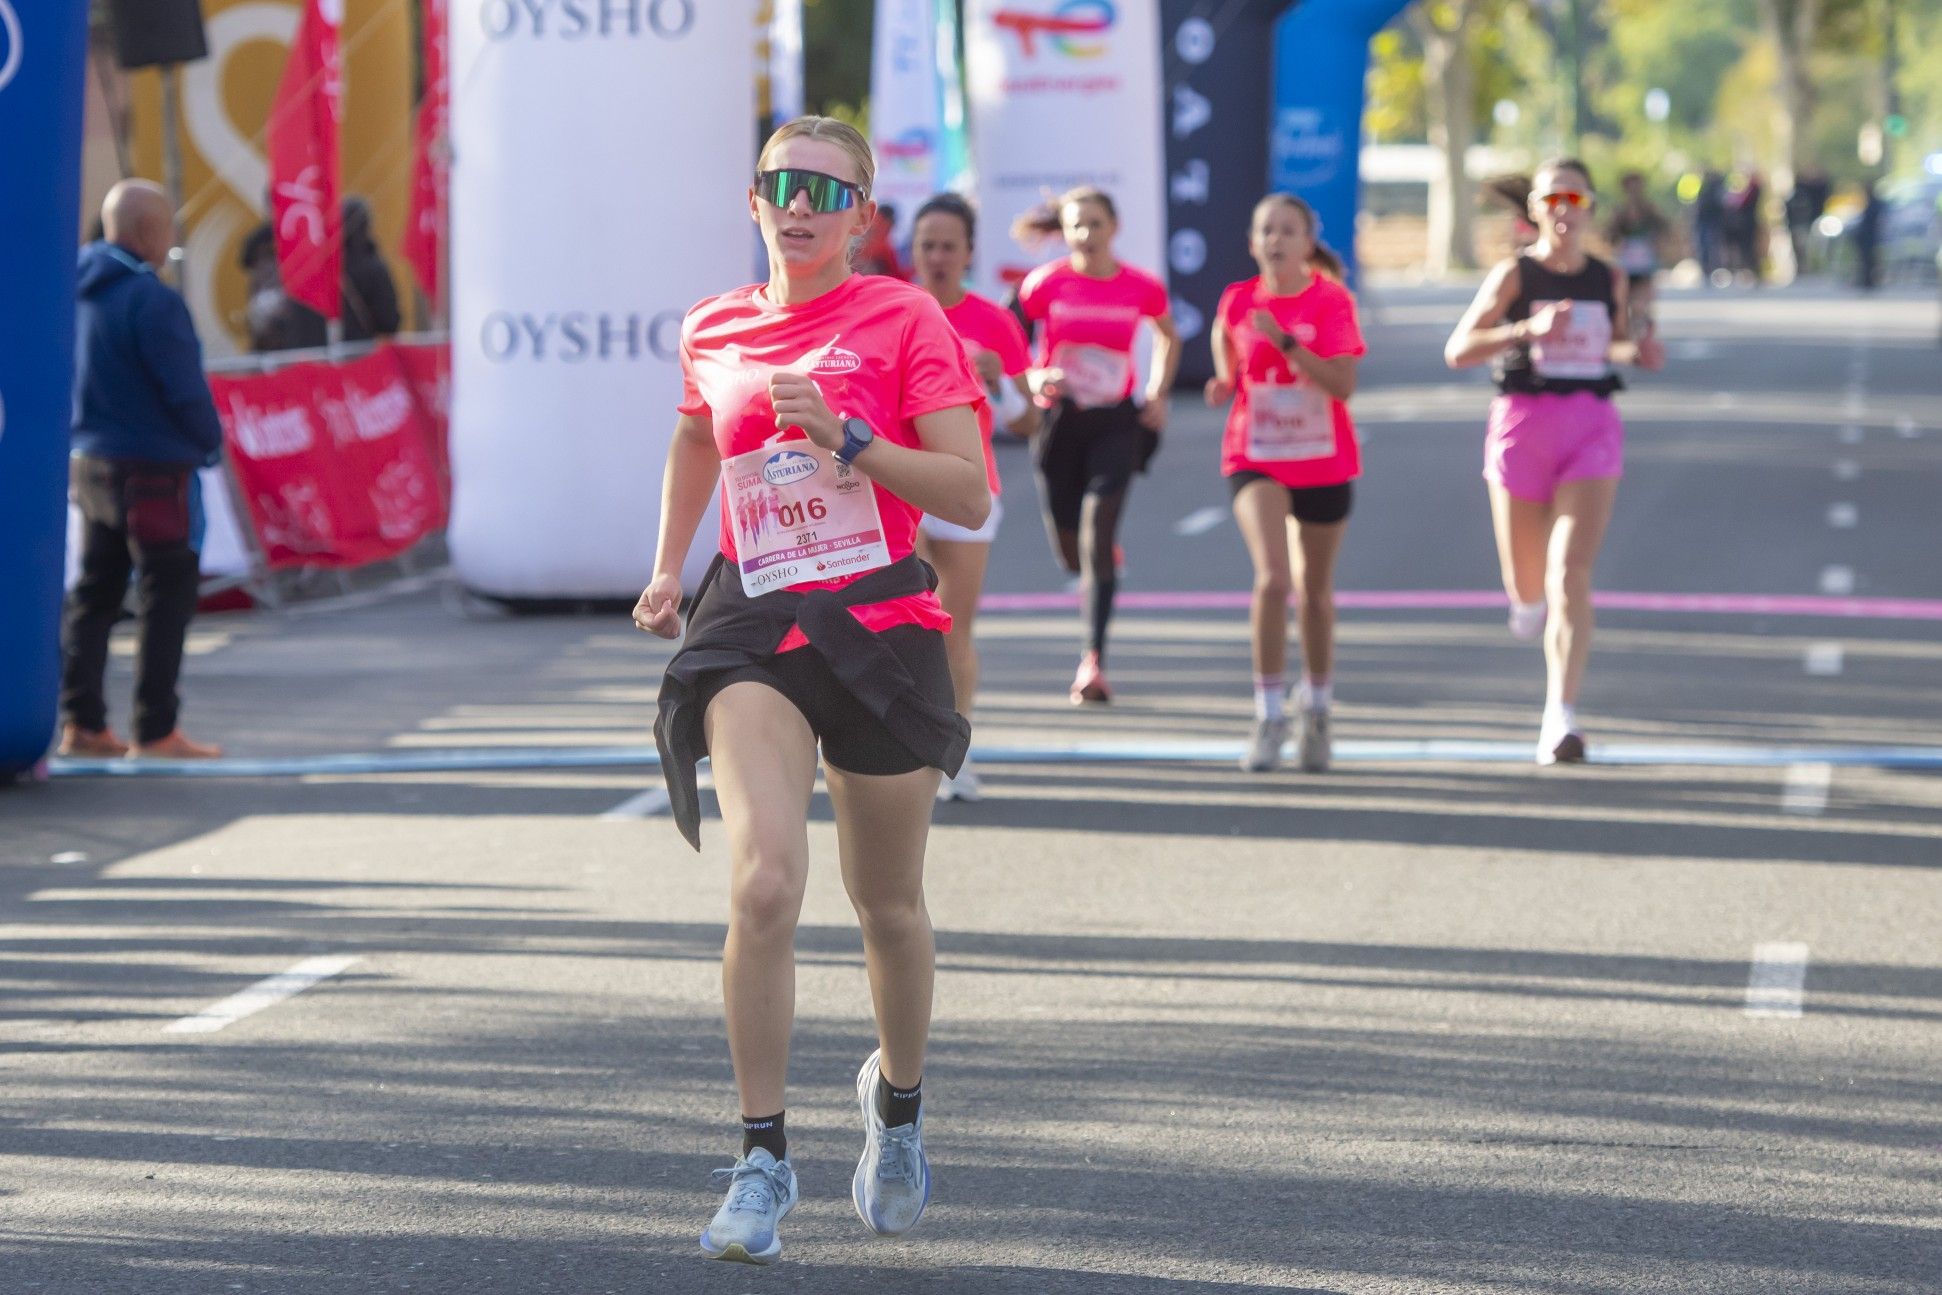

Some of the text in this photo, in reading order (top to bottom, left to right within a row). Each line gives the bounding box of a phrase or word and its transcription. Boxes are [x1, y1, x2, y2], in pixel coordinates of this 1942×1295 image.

[479, 0, 696, 42] OYSHO
[1170, 17, 1215, 342] VOLVO
[480, 308, 684, 365] OYSHO
[812, 358, 857, 368] STURIANA
[766, 462, 815, 481] ASTURIANA
[737, 476, 762, 490] SUMA
[778, 497, 827, 527] 016
[796, 531, 818, 545] 2371
[758, 536, 862, 566] CARRERA DE LA MUJER SEVILLA
[826, 552, 871, 569] Santander
[757, 566, 798, 586] OYSHO
